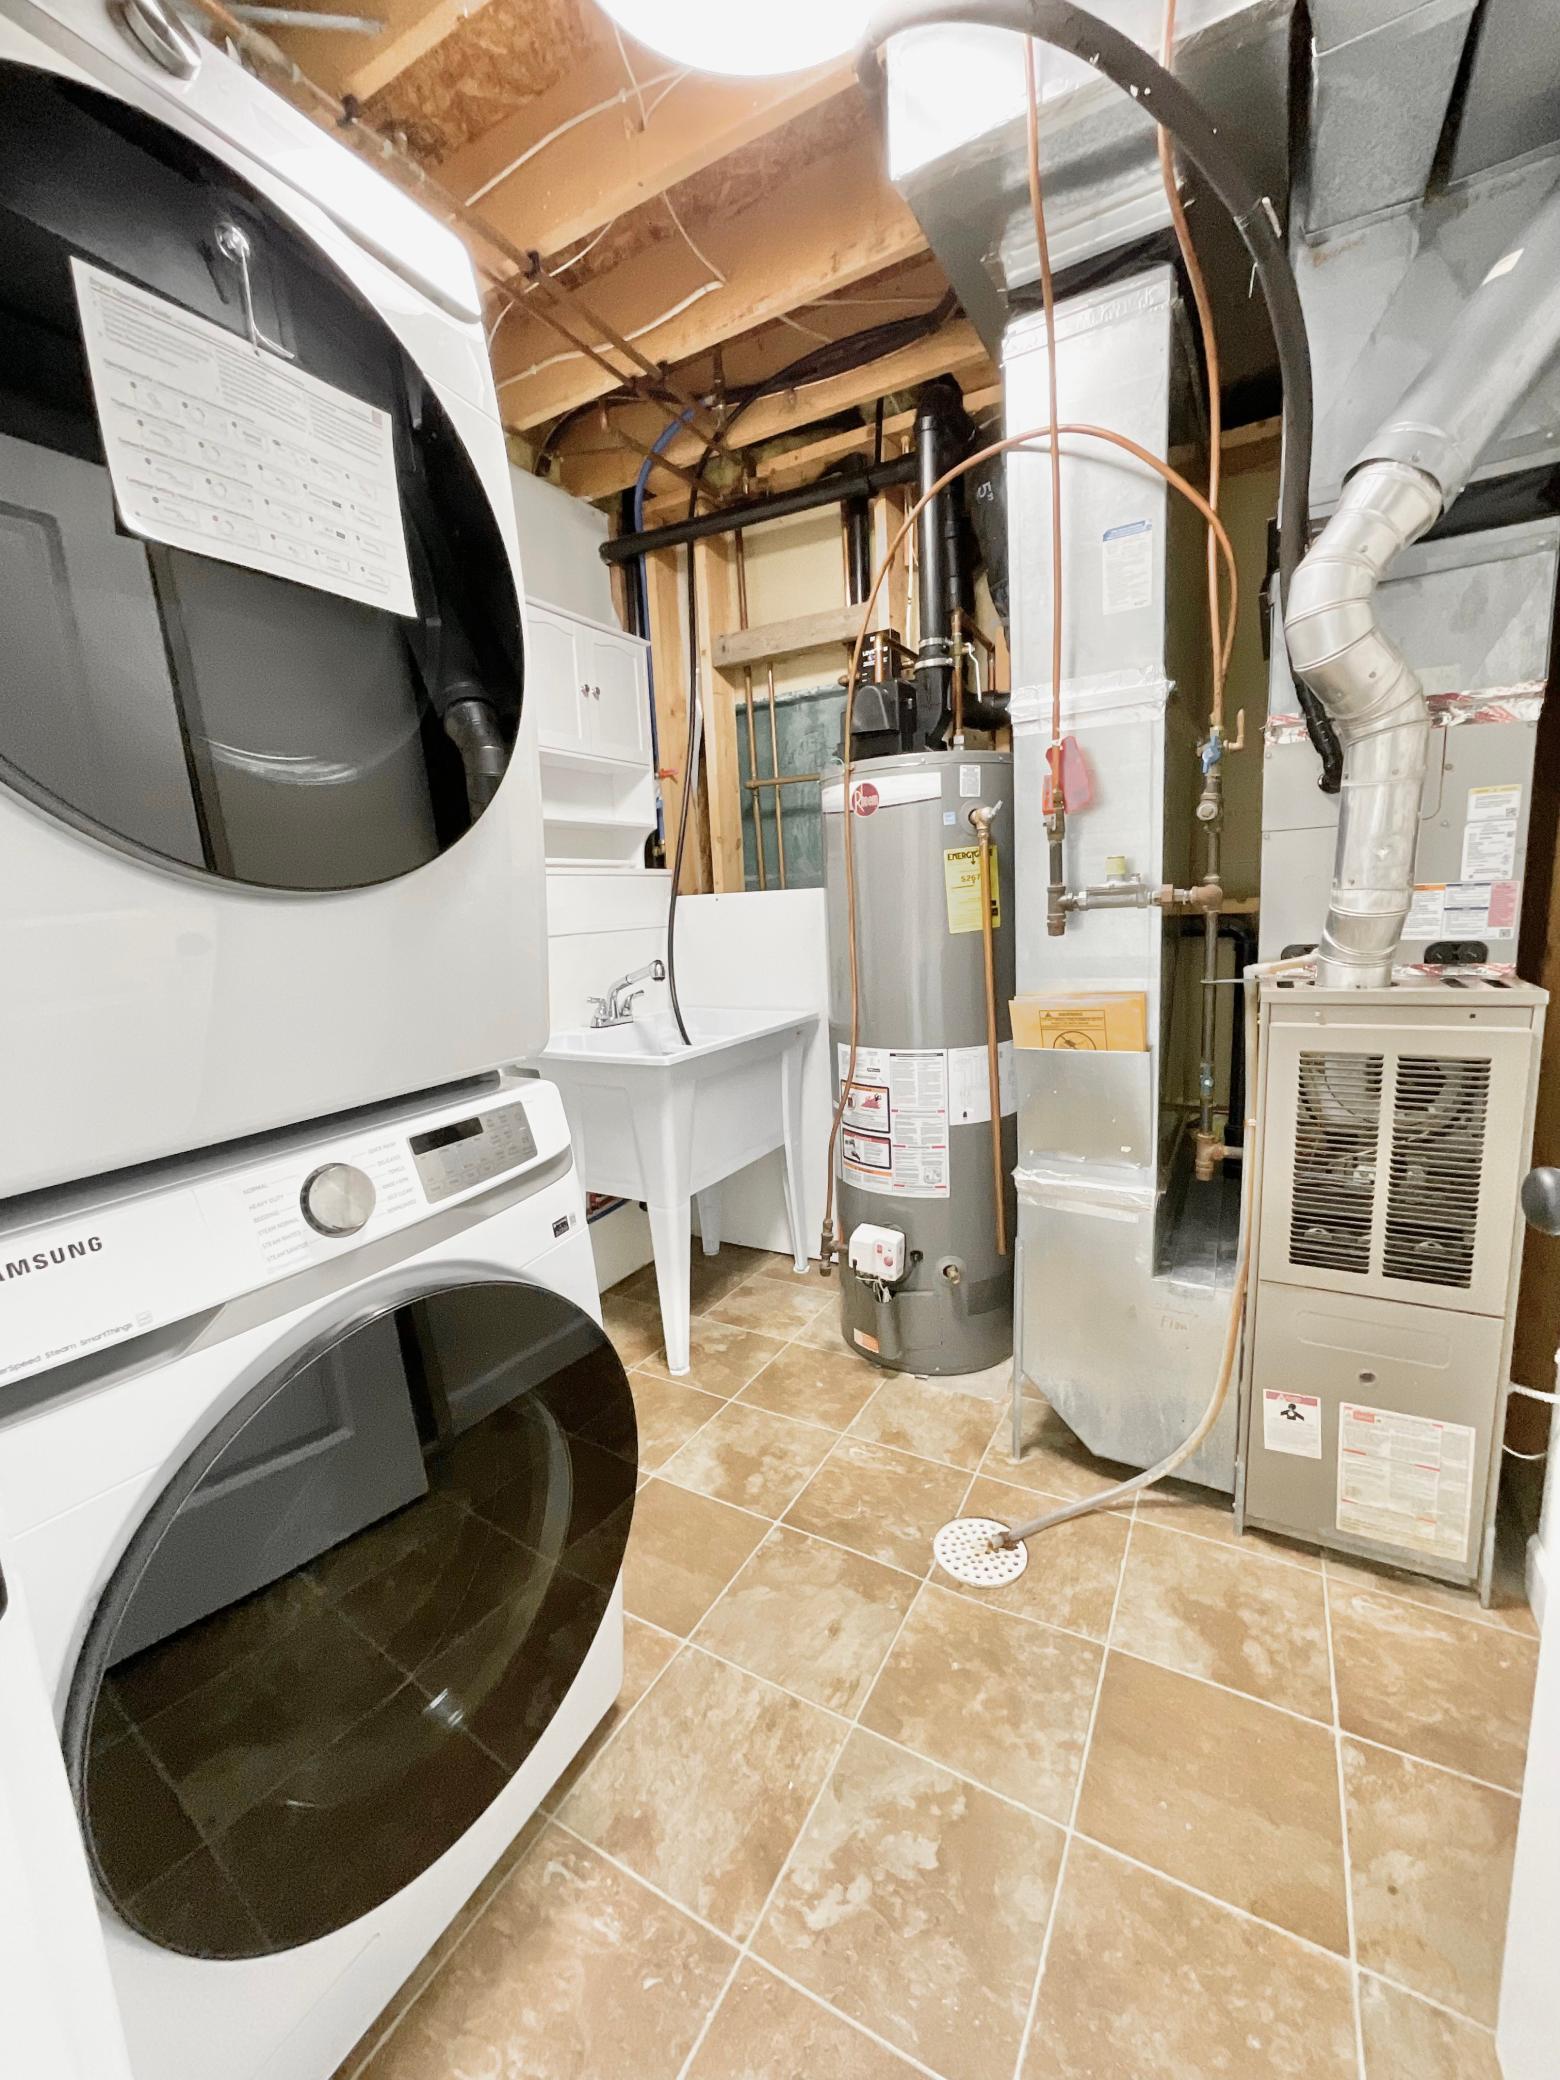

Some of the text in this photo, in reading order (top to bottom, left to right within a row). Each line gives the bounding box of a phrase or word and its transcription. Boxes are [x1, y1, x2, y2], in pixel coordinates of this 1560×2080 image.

[0, 1236, 103, 1282] MSUNG
[44, 1343, 78, 1359] Steam
[79, 1322, 134, 1346] SmartThings
